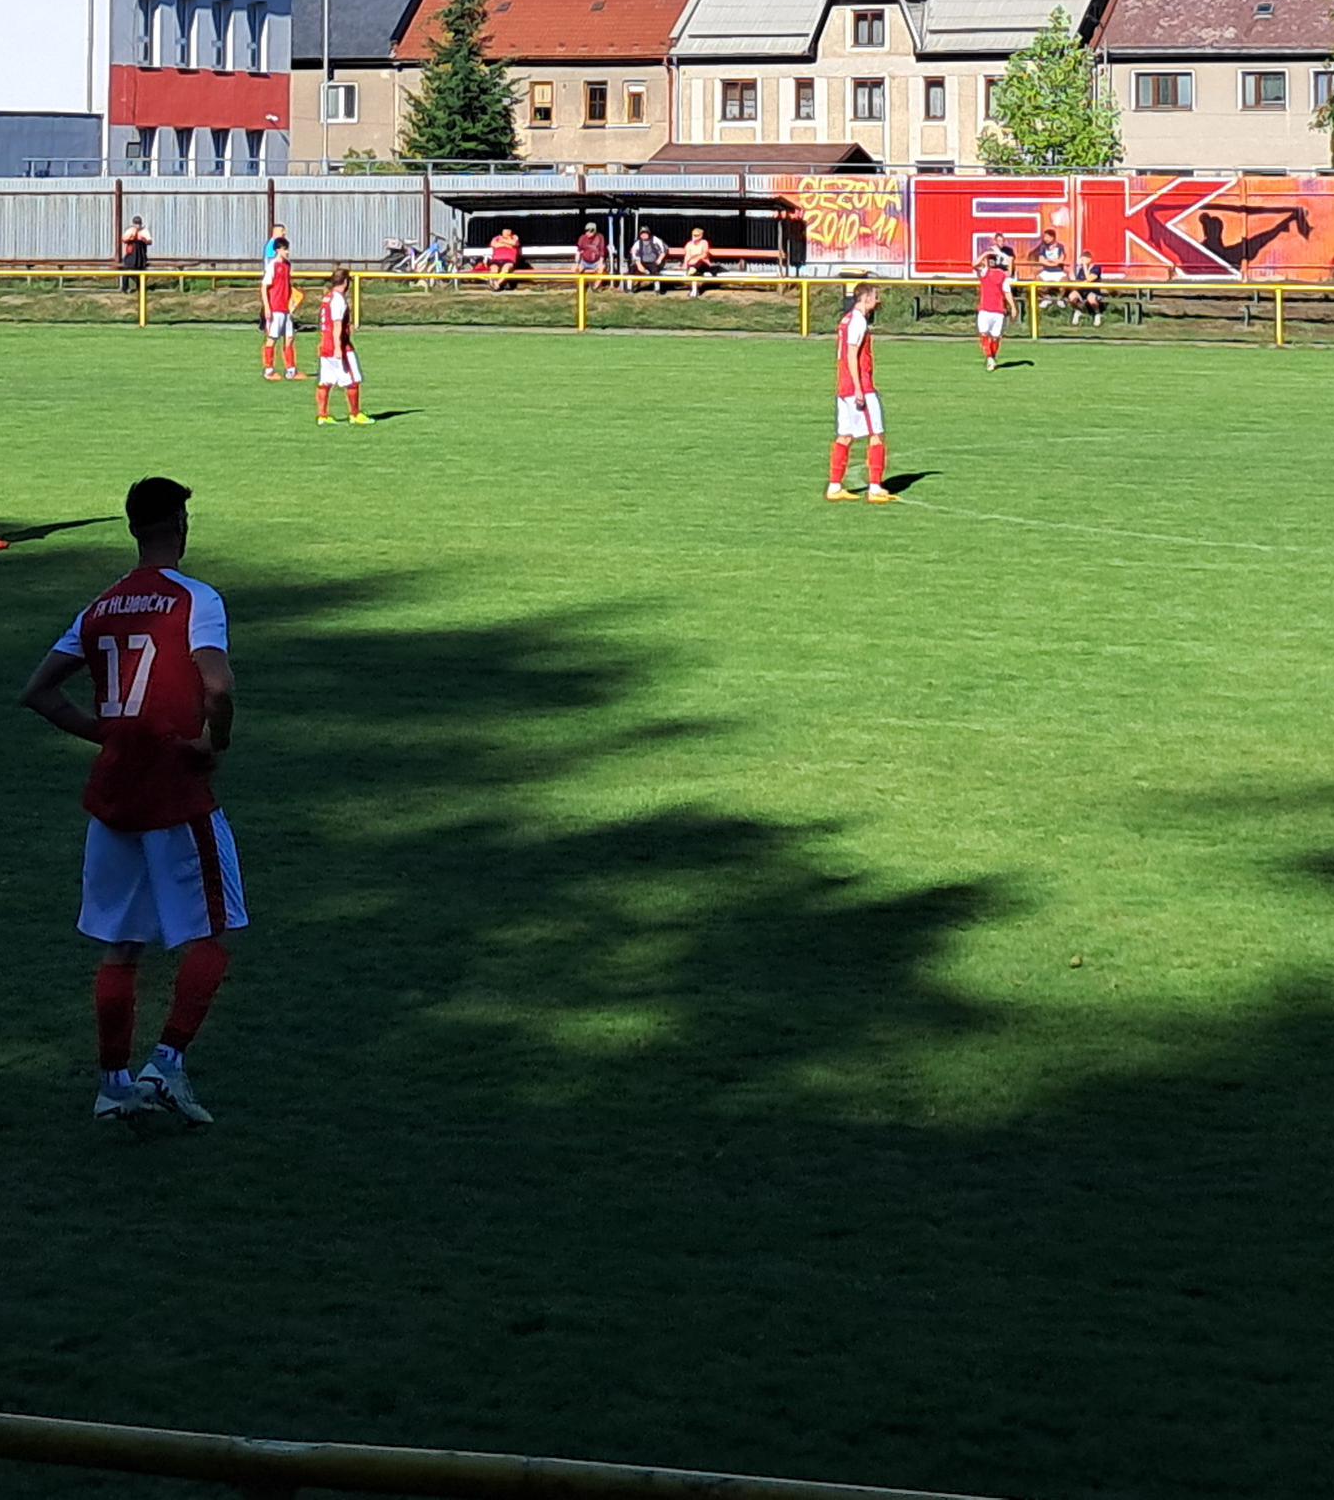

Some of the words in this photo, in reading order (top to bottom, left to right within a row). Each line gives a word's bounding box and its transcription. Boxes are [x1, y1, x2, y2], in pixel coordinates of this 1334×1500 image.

[803, 209, 897, 246] 2010-11
[909, 176, 1241, 281] FK
[98, 634, 156, 717] 17
